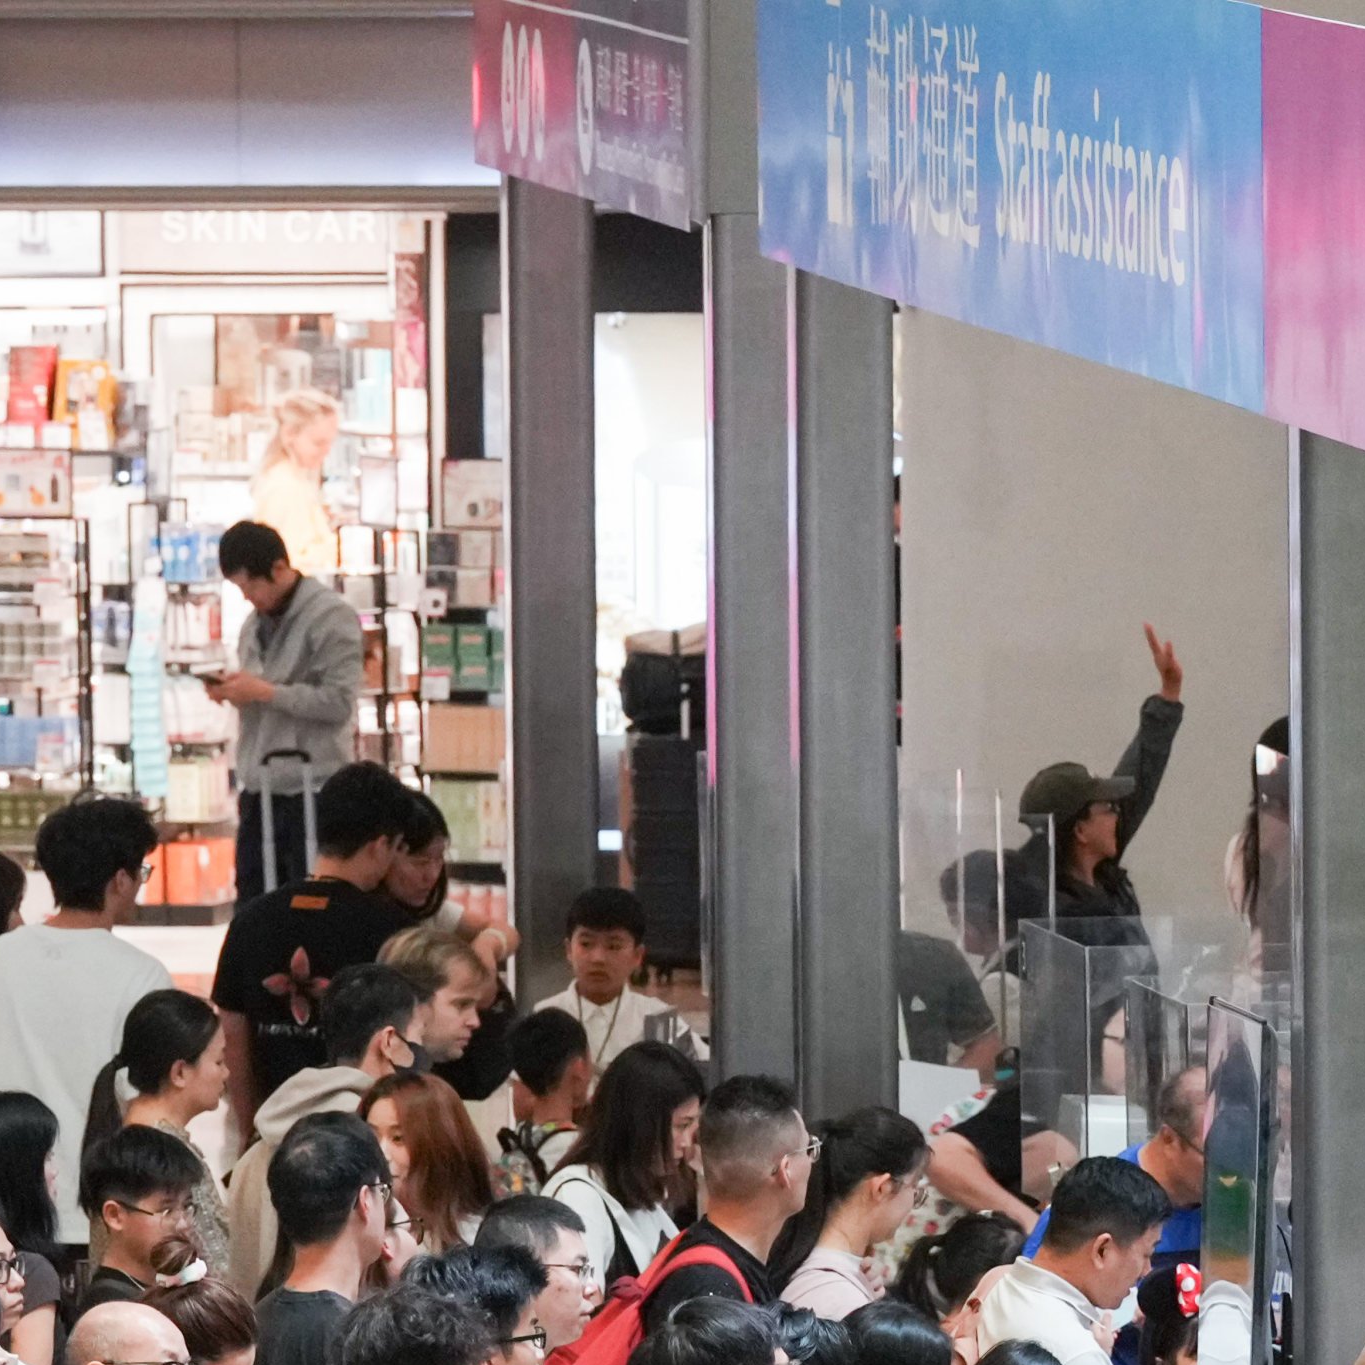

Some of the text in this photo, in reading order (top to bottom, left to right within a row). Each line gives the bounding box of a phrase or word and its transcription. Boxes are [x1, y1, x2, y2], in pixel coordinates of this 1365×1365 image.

[161, 210, 386, 243] SKIN CAR
[867, 5, 980, 248] 輔助通道
[995, 72, 1186, 286] Staff assistance
